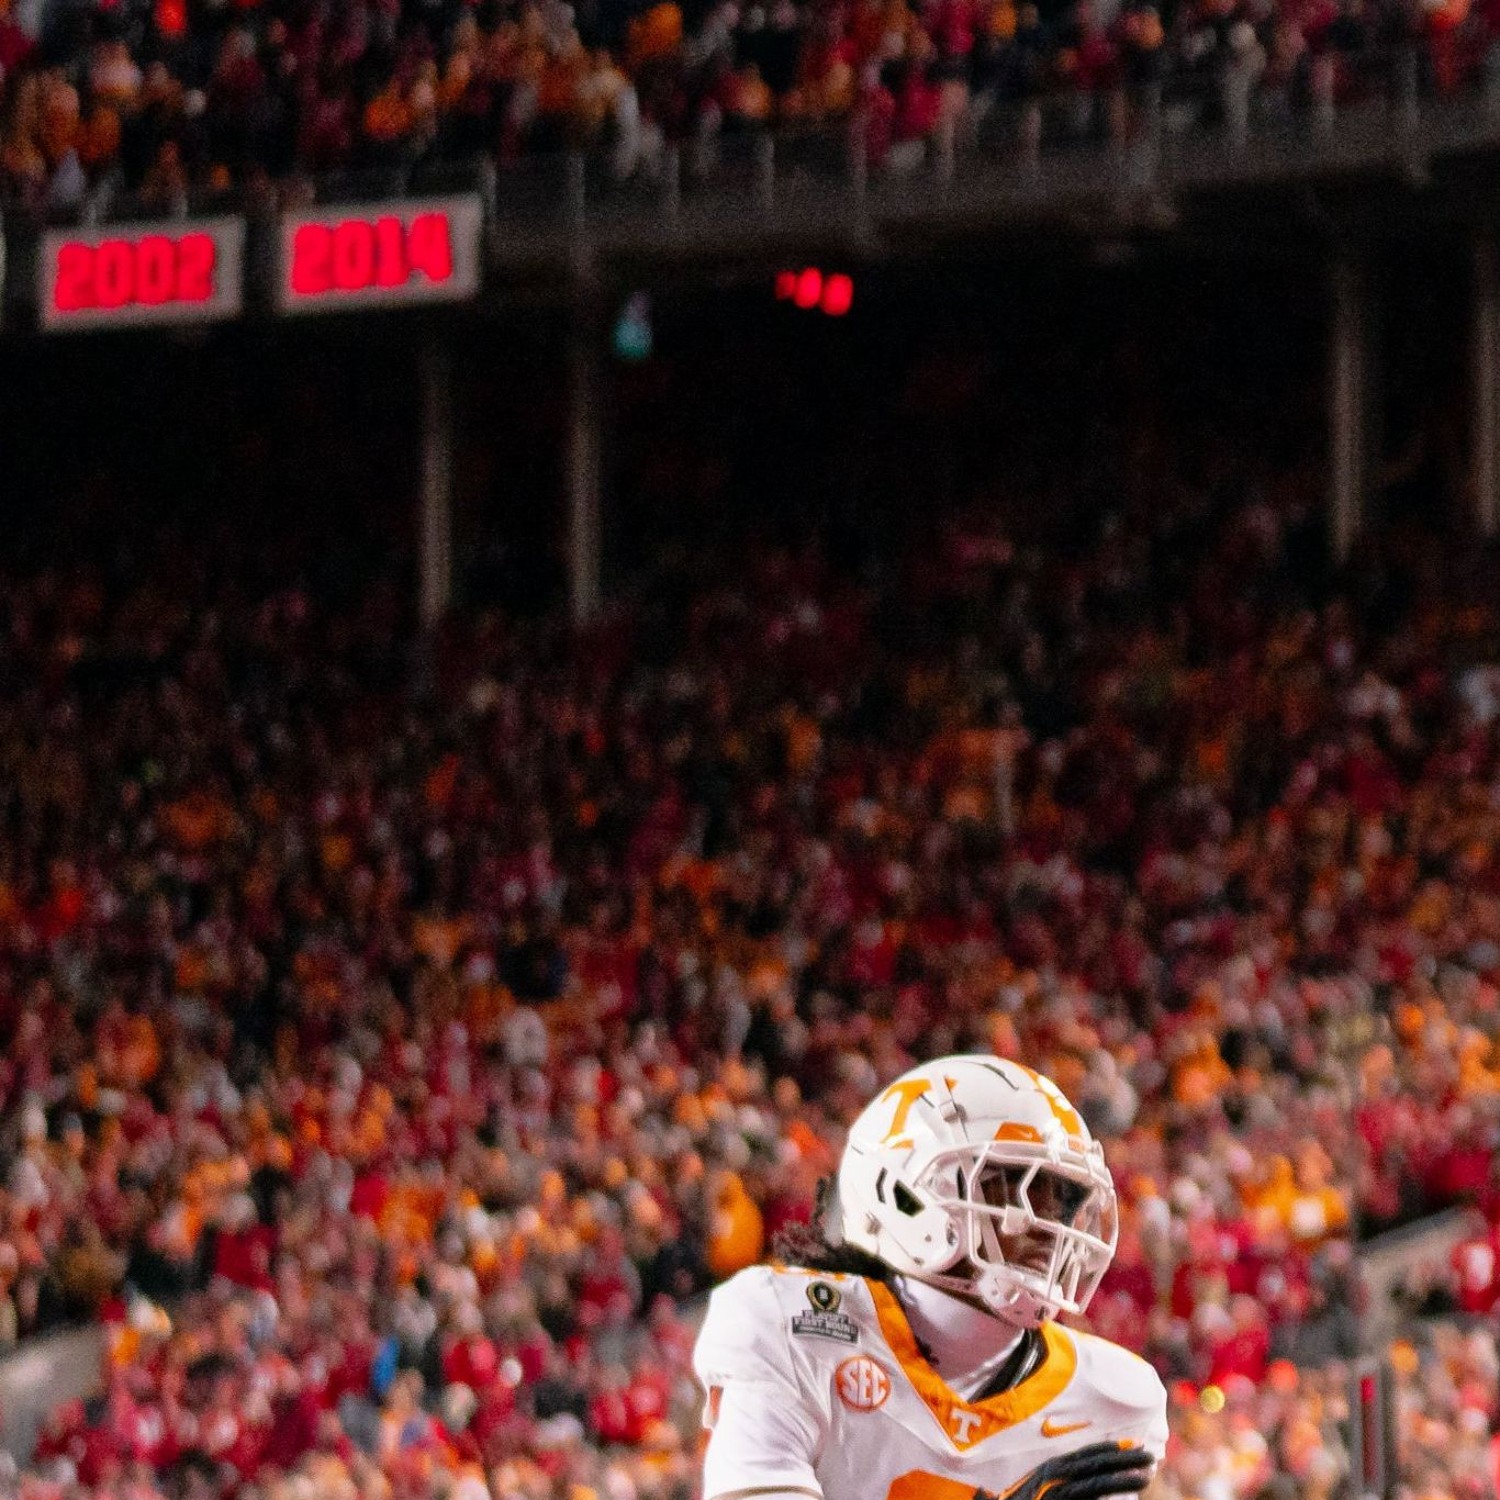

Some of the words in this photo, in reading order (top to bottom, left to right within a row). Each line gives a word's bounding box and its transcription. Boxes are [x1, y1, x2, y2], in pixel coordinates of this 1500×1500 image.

[54, 233, 215, 312] 2002
[292, 212, 453, 295] 2014
[841, 1360, 888, 1406] SEC
[951, 1408, 982, 1444] T
